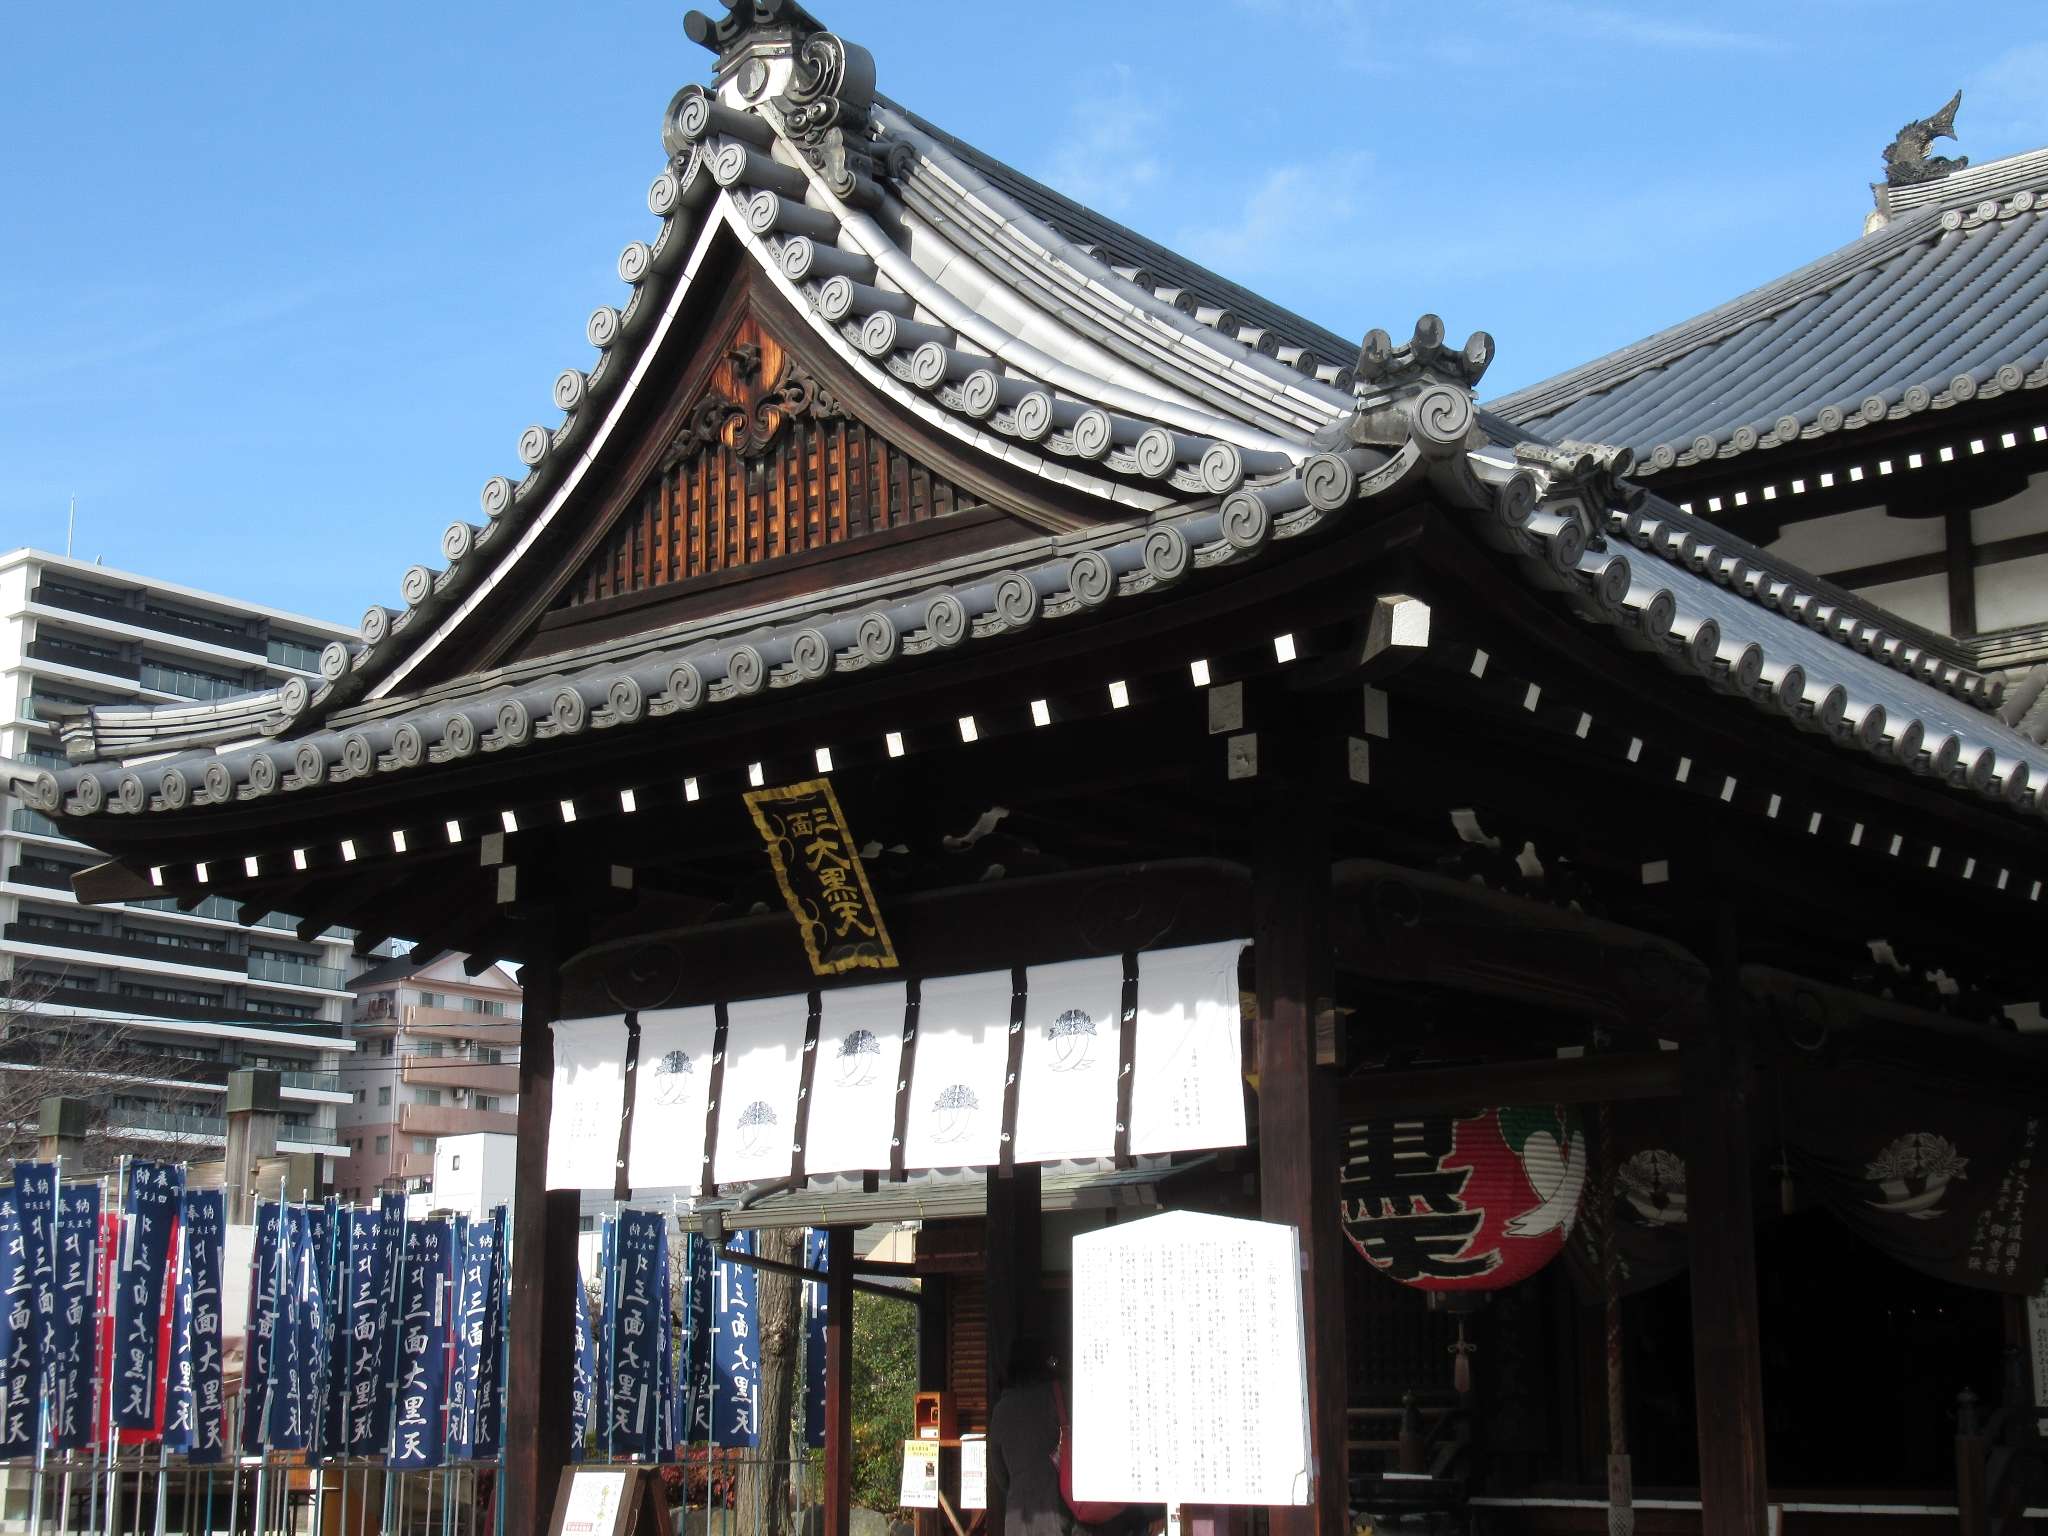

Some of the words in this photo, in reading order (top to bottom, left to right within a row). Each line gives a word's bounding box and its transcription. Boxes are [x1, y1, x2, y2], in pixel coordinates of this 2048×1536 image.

[22, 1177, 49, 1197] 奉納
[24, 1201, 51, 1211] 四天王寺
[59, 1198, 90, 1216] 奉納
[188, 1203, 215, 1220] 奉納
[407, 1233, 438, 1249] 奉納
[407, 1253, 440, 1262] 四天王寺
[5, 1264, 32, 1444] 三面大黒天
[62, 1261, 85, 1436] 三面大黒天
[192, 1269, 222, 1449] 三面大黒天
[350, 1282, 377, 1443] 三面大黒天
[399, 1294, 430, 1460] 三面大黒天
